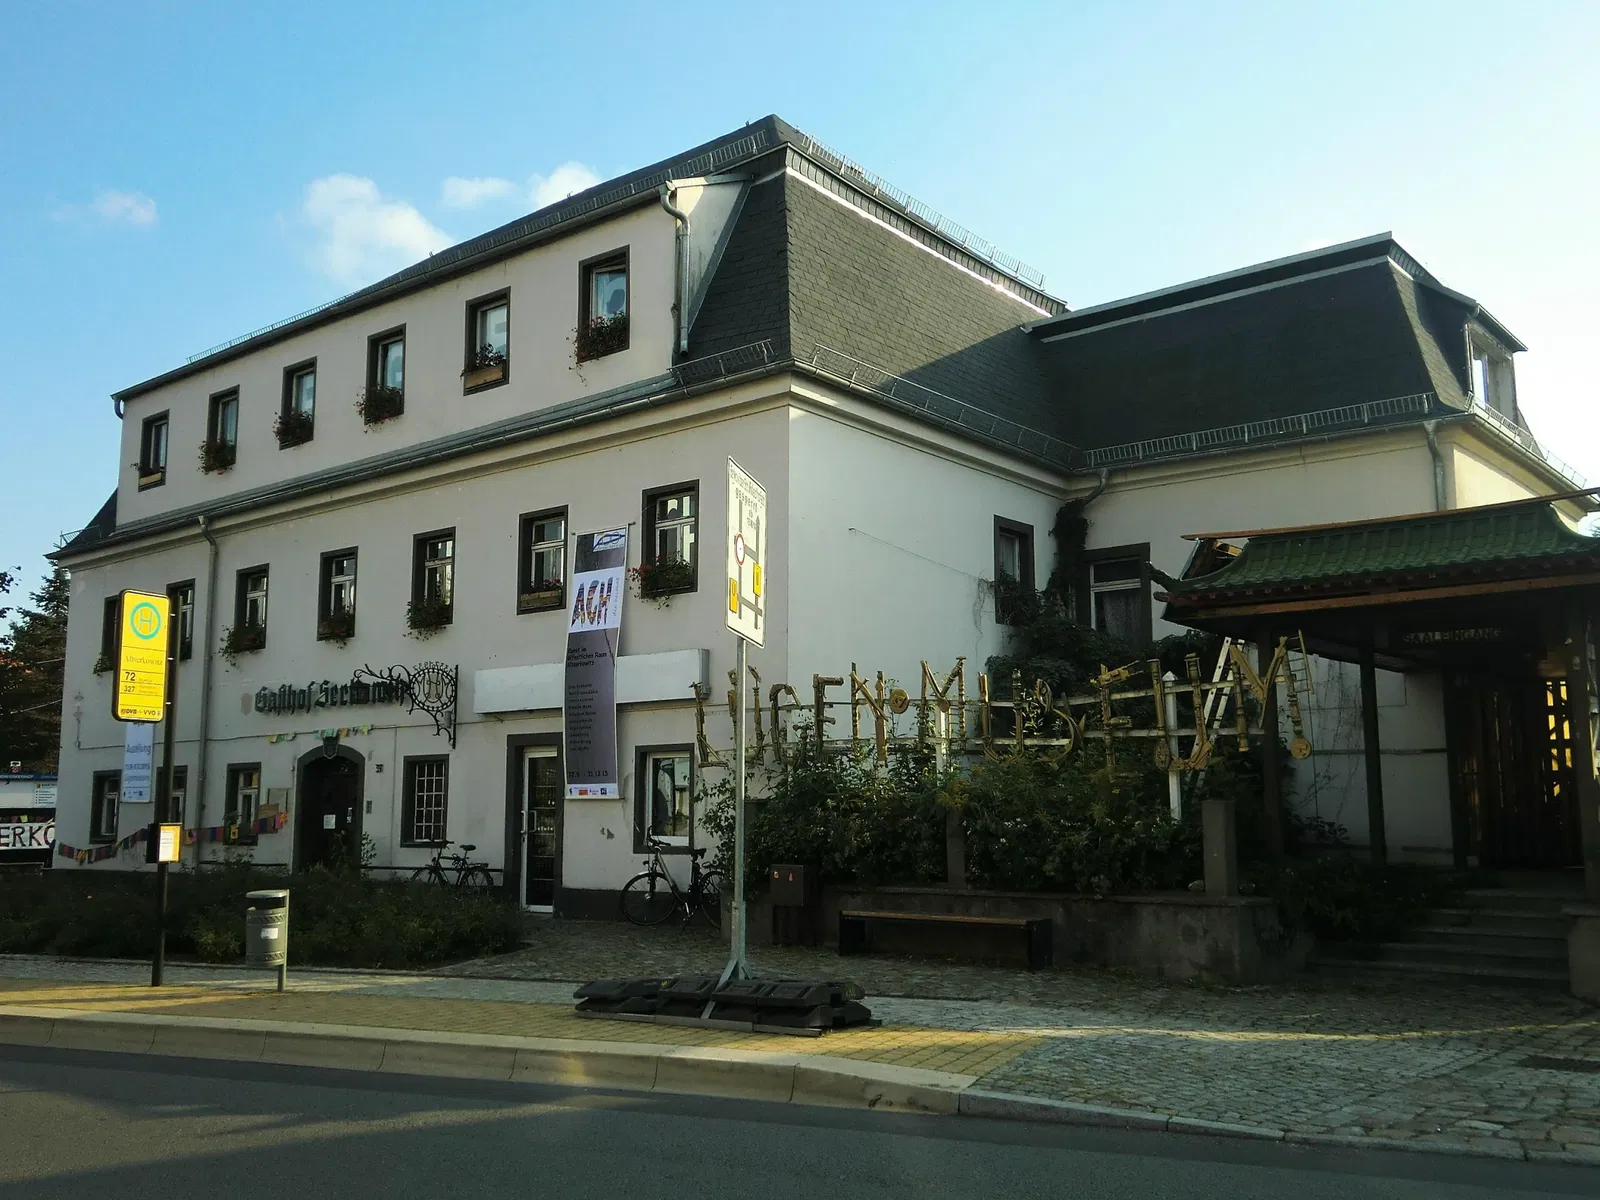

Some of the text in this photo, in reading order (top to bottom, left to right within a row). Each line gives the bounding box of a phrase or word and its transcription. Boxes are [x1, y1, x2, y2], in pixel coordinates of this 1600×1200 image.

[571, 577, 613, 627] ACH
[139, 609, 153, 632] H
[125, 672, 136, 681] 72
[124, 685, 136, 693] 327
[256, 681, 315, 715] Gasthof
